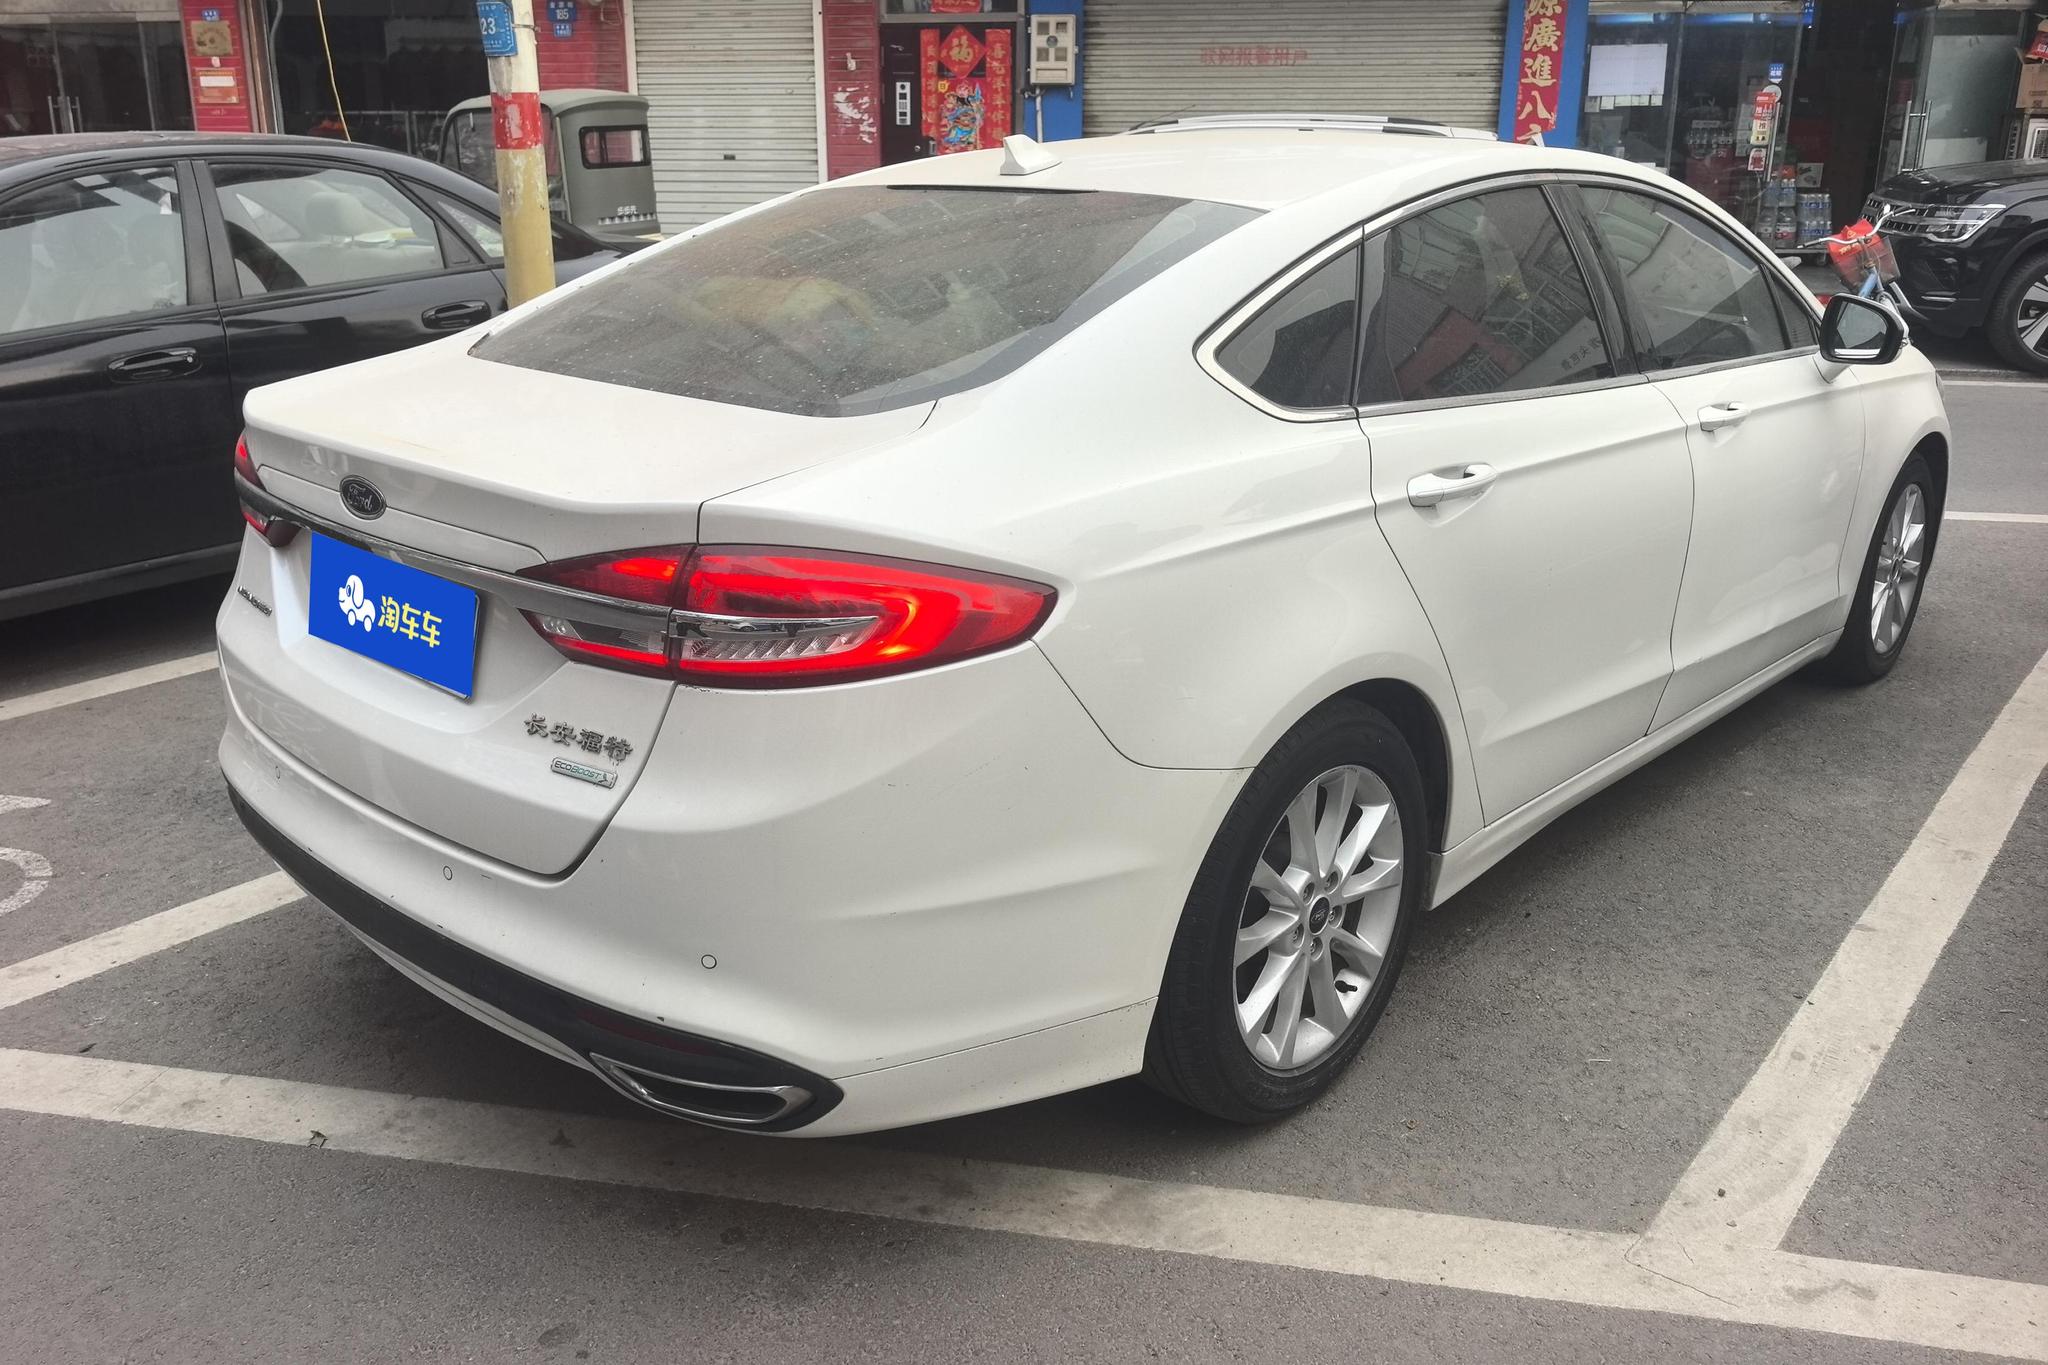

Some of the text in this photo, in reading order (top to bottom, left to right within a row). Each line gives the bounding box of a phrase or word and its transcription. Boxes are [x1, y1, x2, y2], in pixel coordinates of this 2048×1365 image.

[949, 35, 974, 63] 福
[524, 712, 634, 762] 长安福特
[554, 760, 602, 780] ECOBOOST
